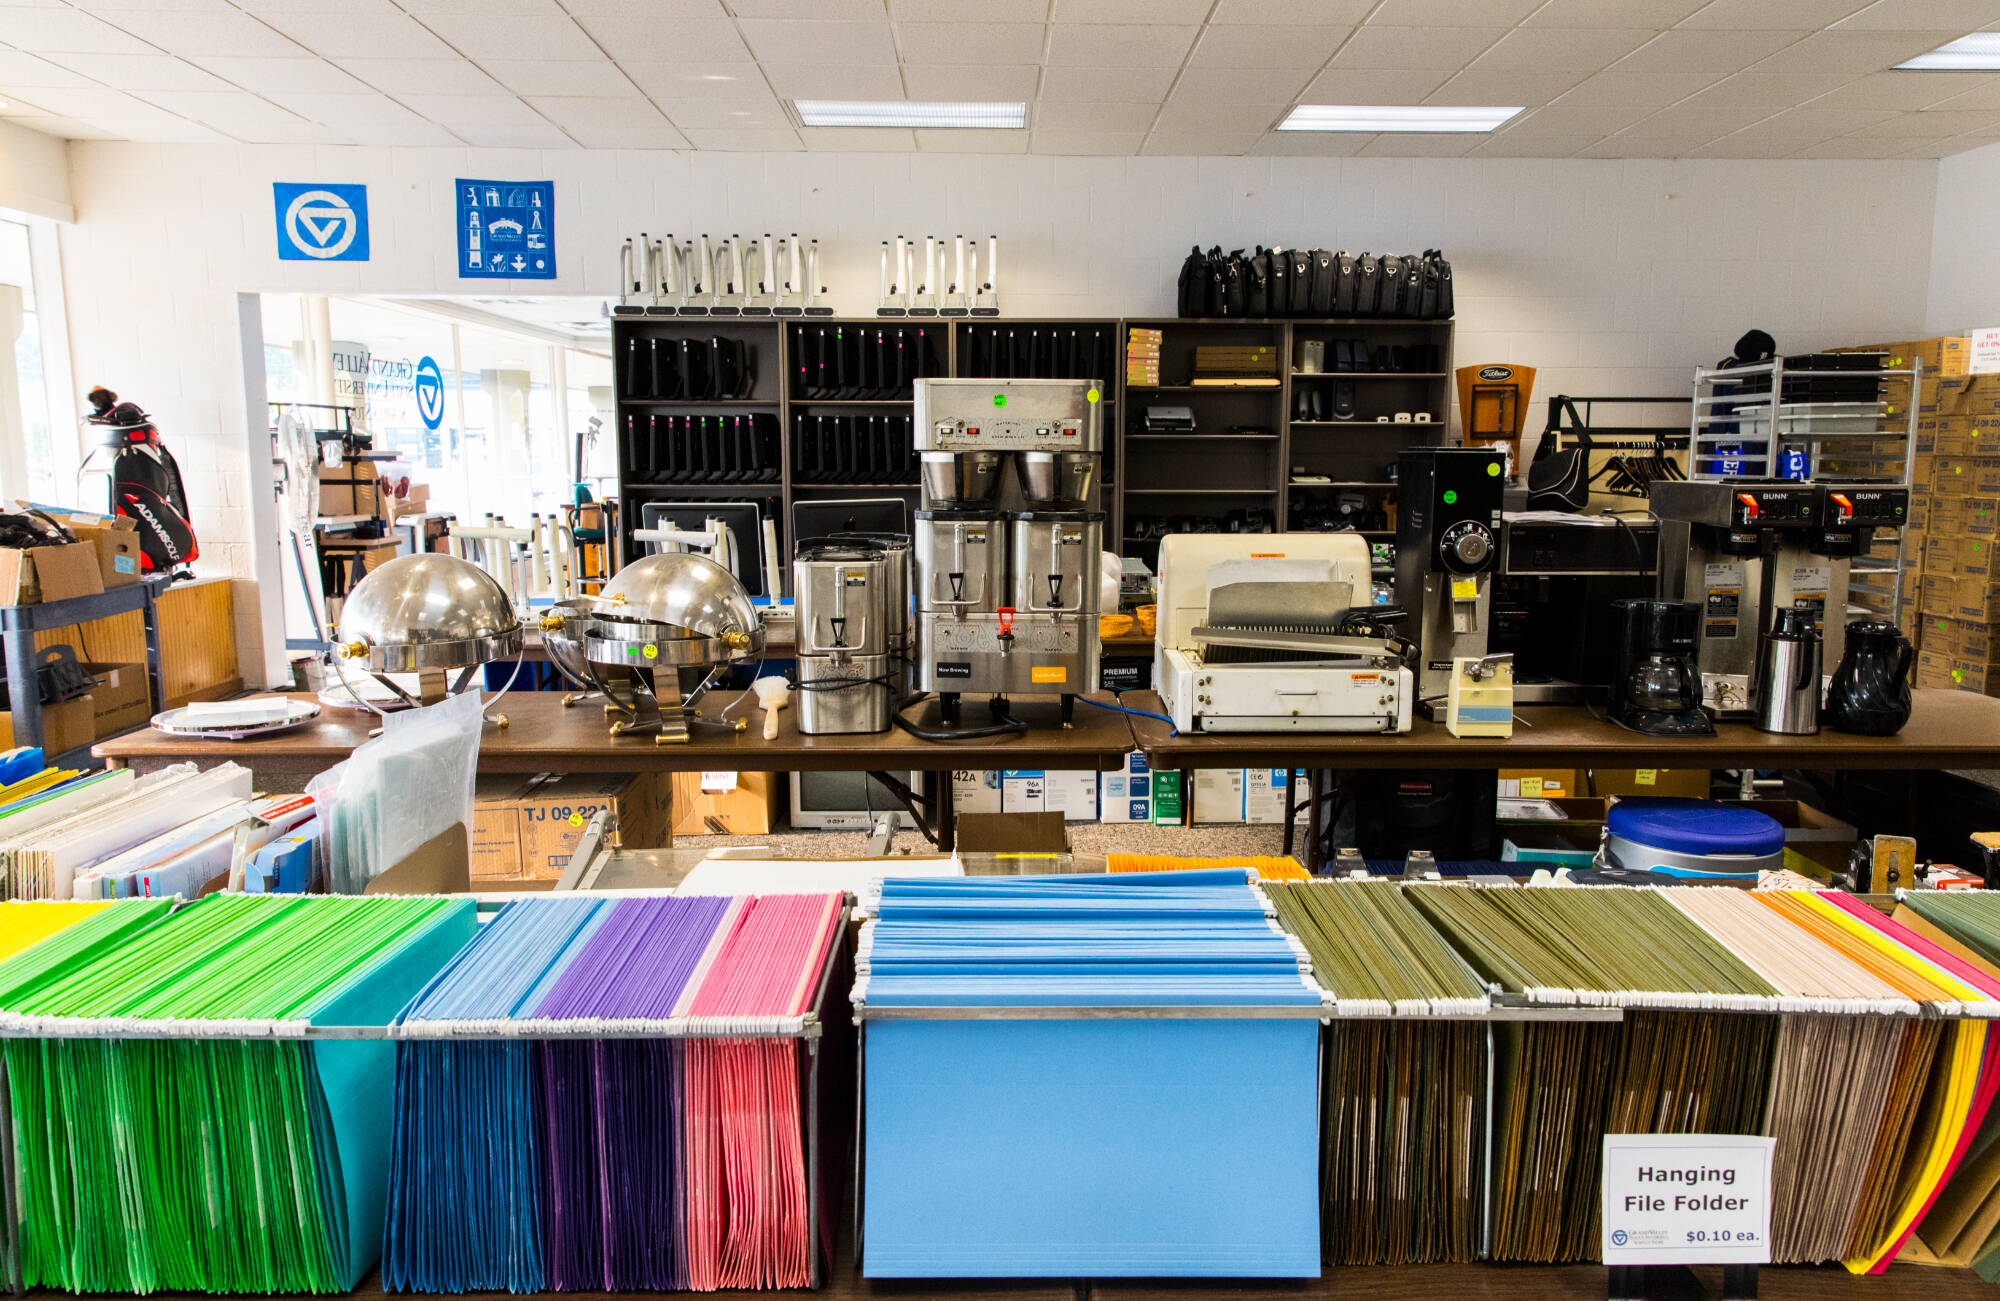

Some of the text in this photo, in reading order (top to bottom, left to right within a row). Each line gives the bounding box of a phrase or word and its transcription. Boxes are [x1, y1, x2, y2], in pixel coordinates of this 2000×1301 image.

[953, 770, 976, 782] 42A
[524, 807, 546, 822] TJ
[552, 806, 571, 820] 09
[1638, 1166, 1736, 1185] Hanging
[1624, 1195, 1749, 1211] File Folder
[1686, 1230, 1760, 1243] $0.10 ea.
